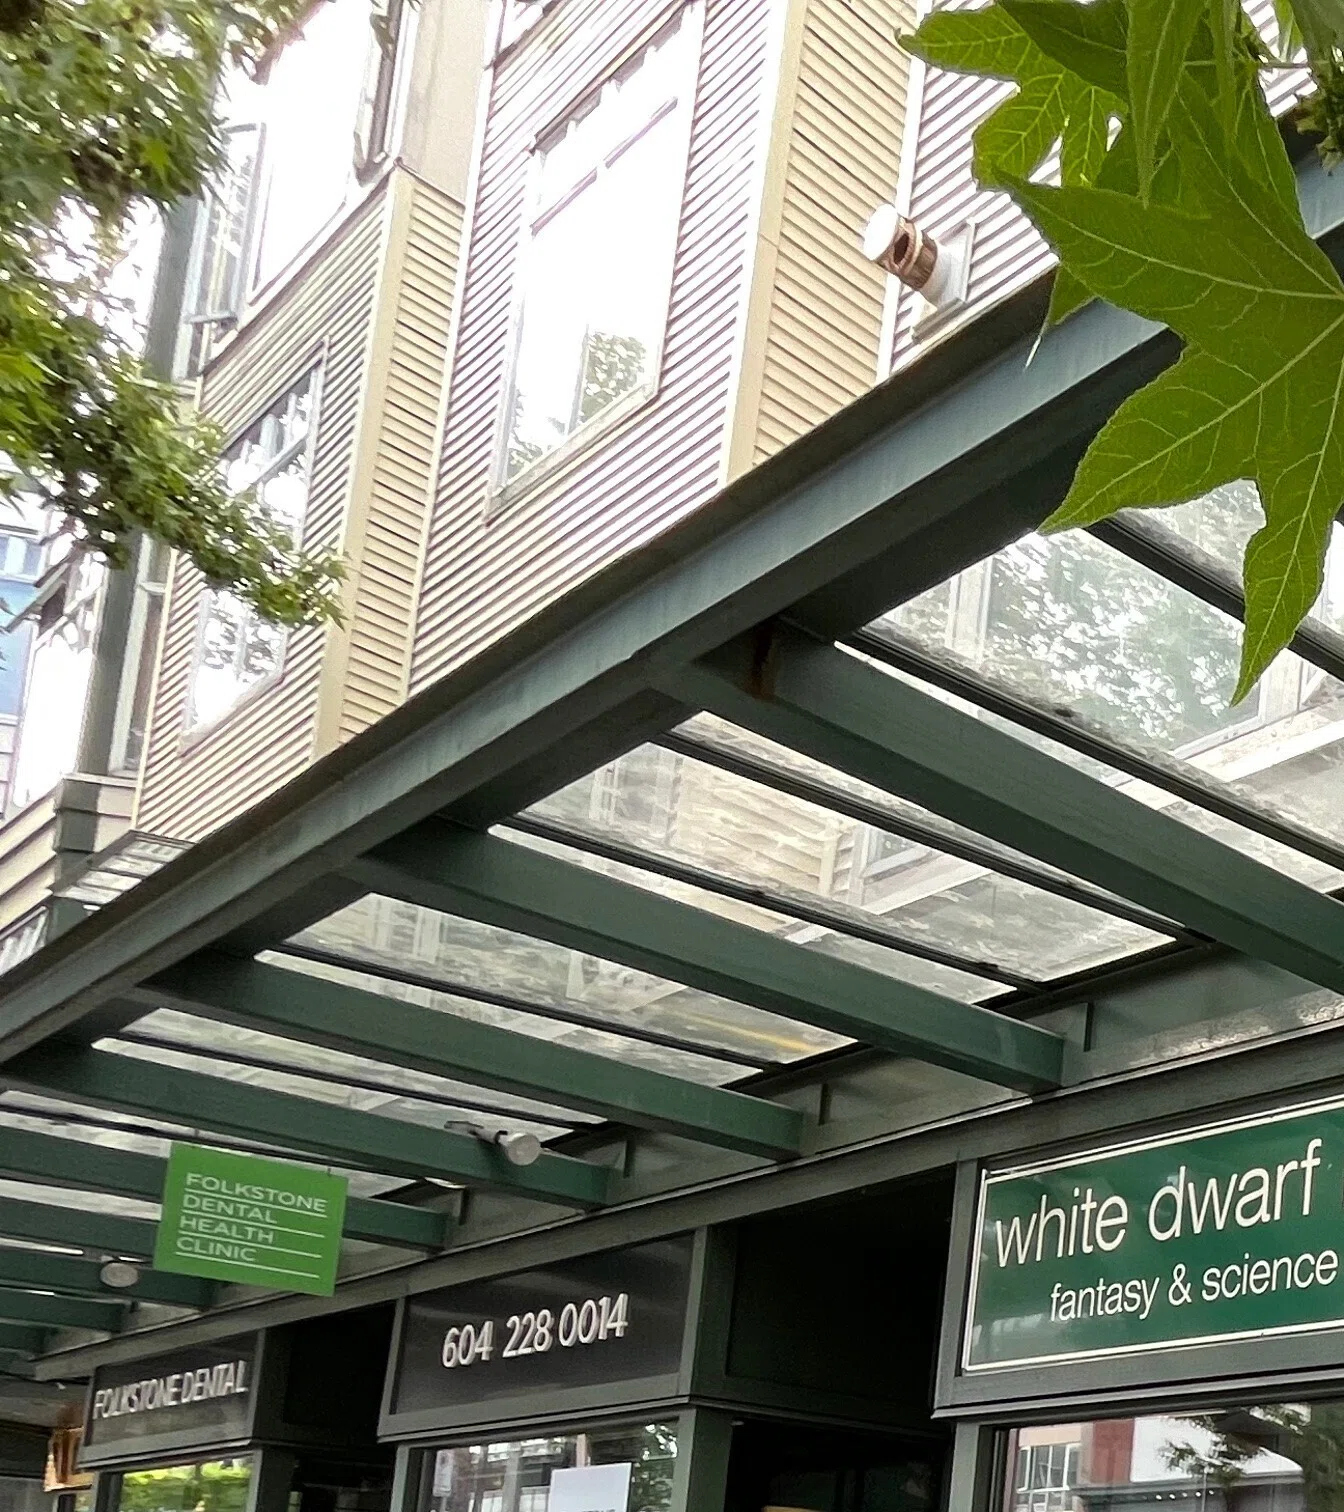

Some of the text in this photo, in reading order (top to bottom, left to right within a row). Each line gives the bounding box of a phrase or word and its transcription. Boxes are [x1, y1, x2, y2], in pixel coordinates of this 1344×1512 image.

[182, 1193, 278, 1225] DENTAL
[185, 1172, 328, 1213] FOLKSTONE
[995, 1186, 1129, 1267] white
[1148, 1138, 1323, 1242] dwarf
[176, 1236, 257, 1262] CLINIC
[179, 1215, 274, 1245] HEALTH
[1050, 1276, 1160, 1321] fantasy
[1168, 1263, 1192, 1306] &
[1202, 1249, 1339, 1302] science
[442, 1292, 629, 1368] 604 228 0014
[92, 1359, 249, 1420] FOLKSTONE DENTAL
